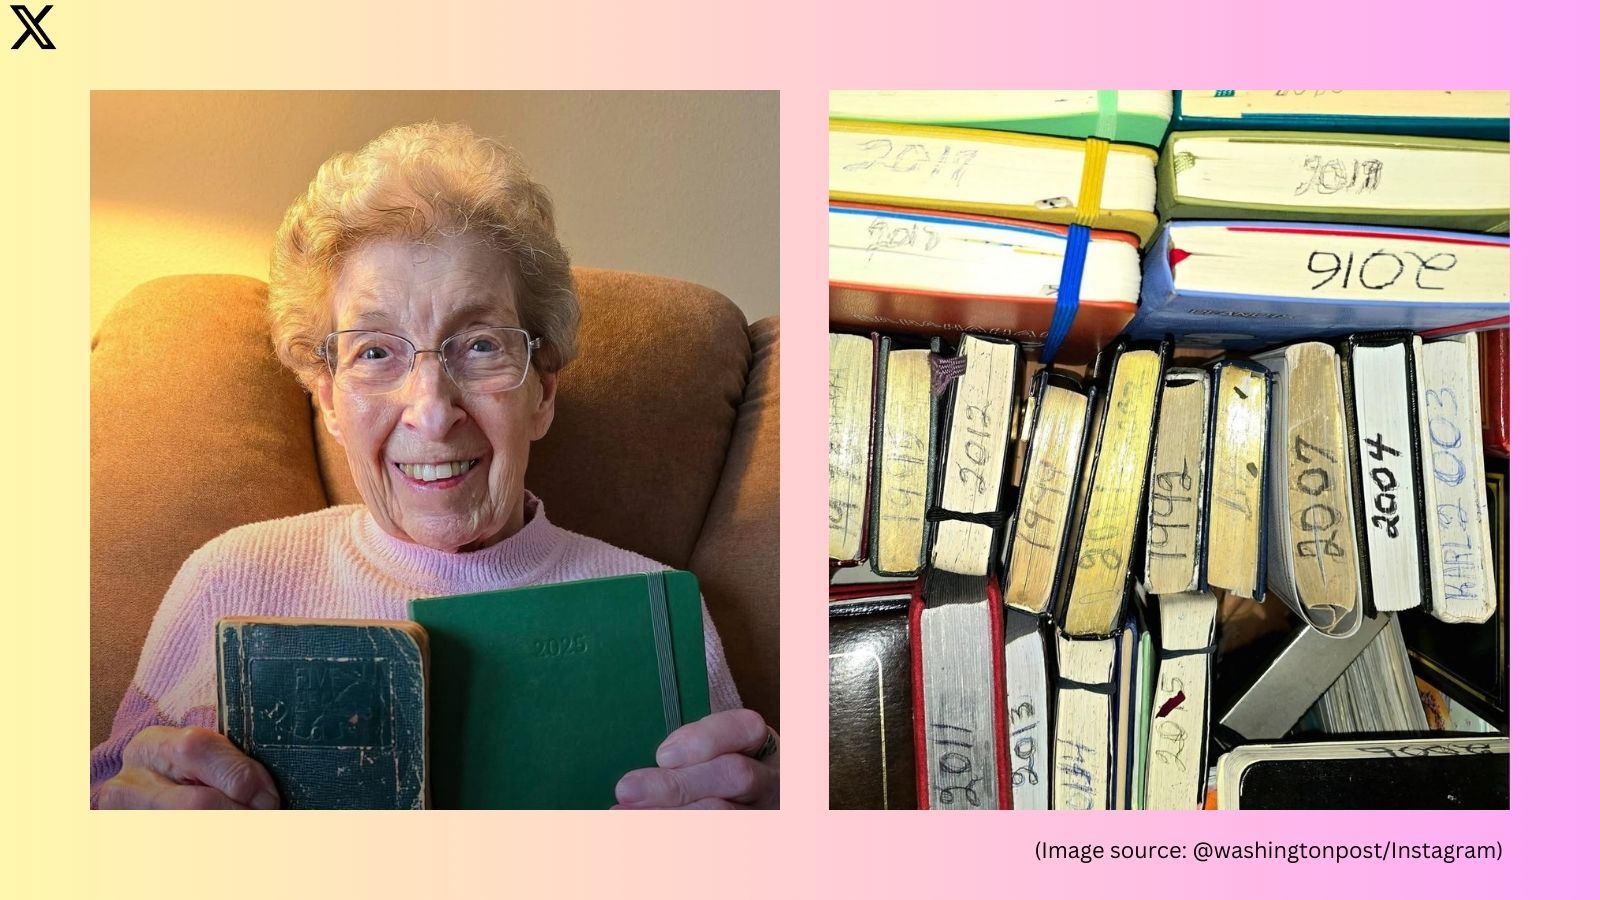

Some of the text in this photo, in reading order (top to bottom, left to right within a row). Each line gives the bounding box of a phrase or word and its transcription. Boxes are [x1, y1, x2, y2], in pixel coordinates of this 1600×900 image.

[957, 401, 994, 495] 2012
[1362, 432, 1402, 539] 2004
[1291, 434, 1346, 559] 2007
[535, 633, 588, 658] 2025
[929, 723, 983, 808] 2011
